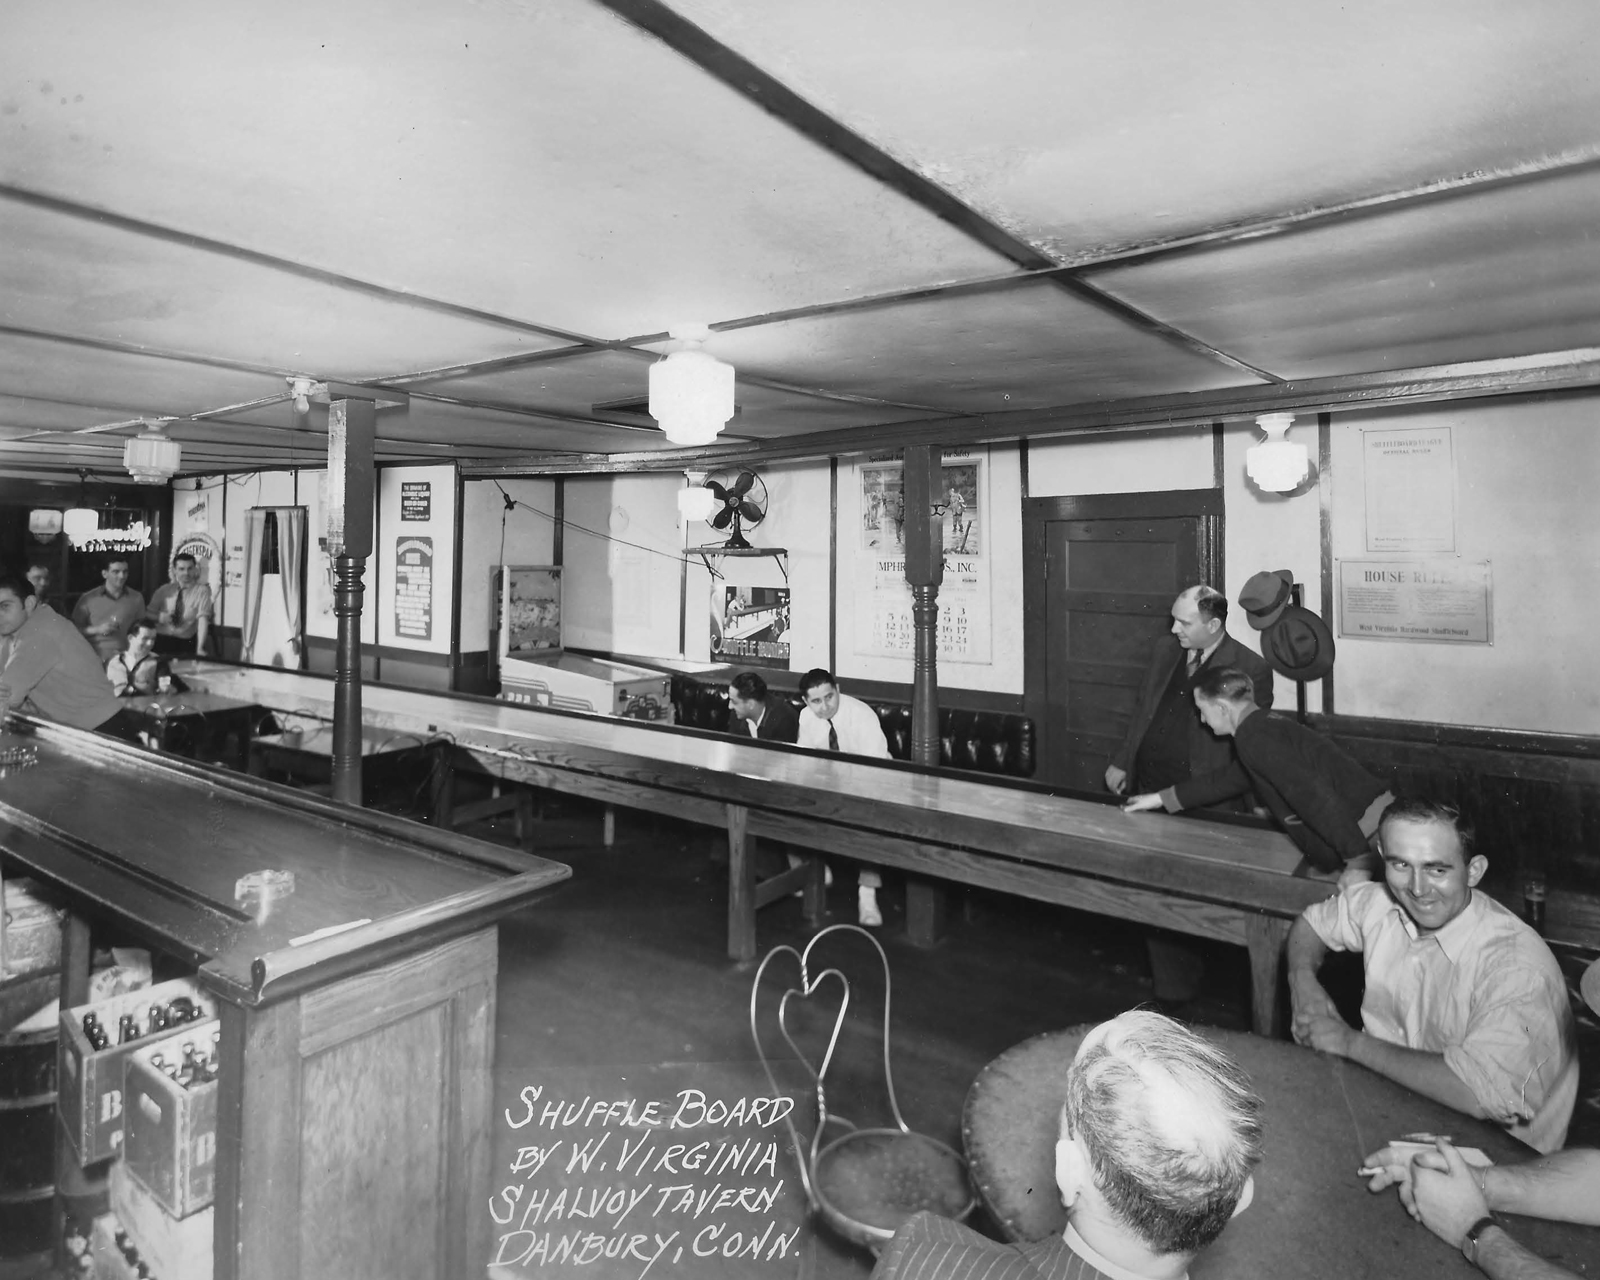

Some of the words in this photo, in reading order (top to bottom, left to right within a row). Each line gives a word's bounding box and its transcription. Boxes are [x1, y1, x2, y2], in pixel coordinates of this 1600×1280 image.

[877, 562, 905, 572] MPHR
[957, 563, 977, 573] INC.
[1364, 570, 1405, 583] HOUSE
[957, 617, 968, 625] 10
[886, 622, 896, 630] 12
[957, 626, 967, 634] 17
